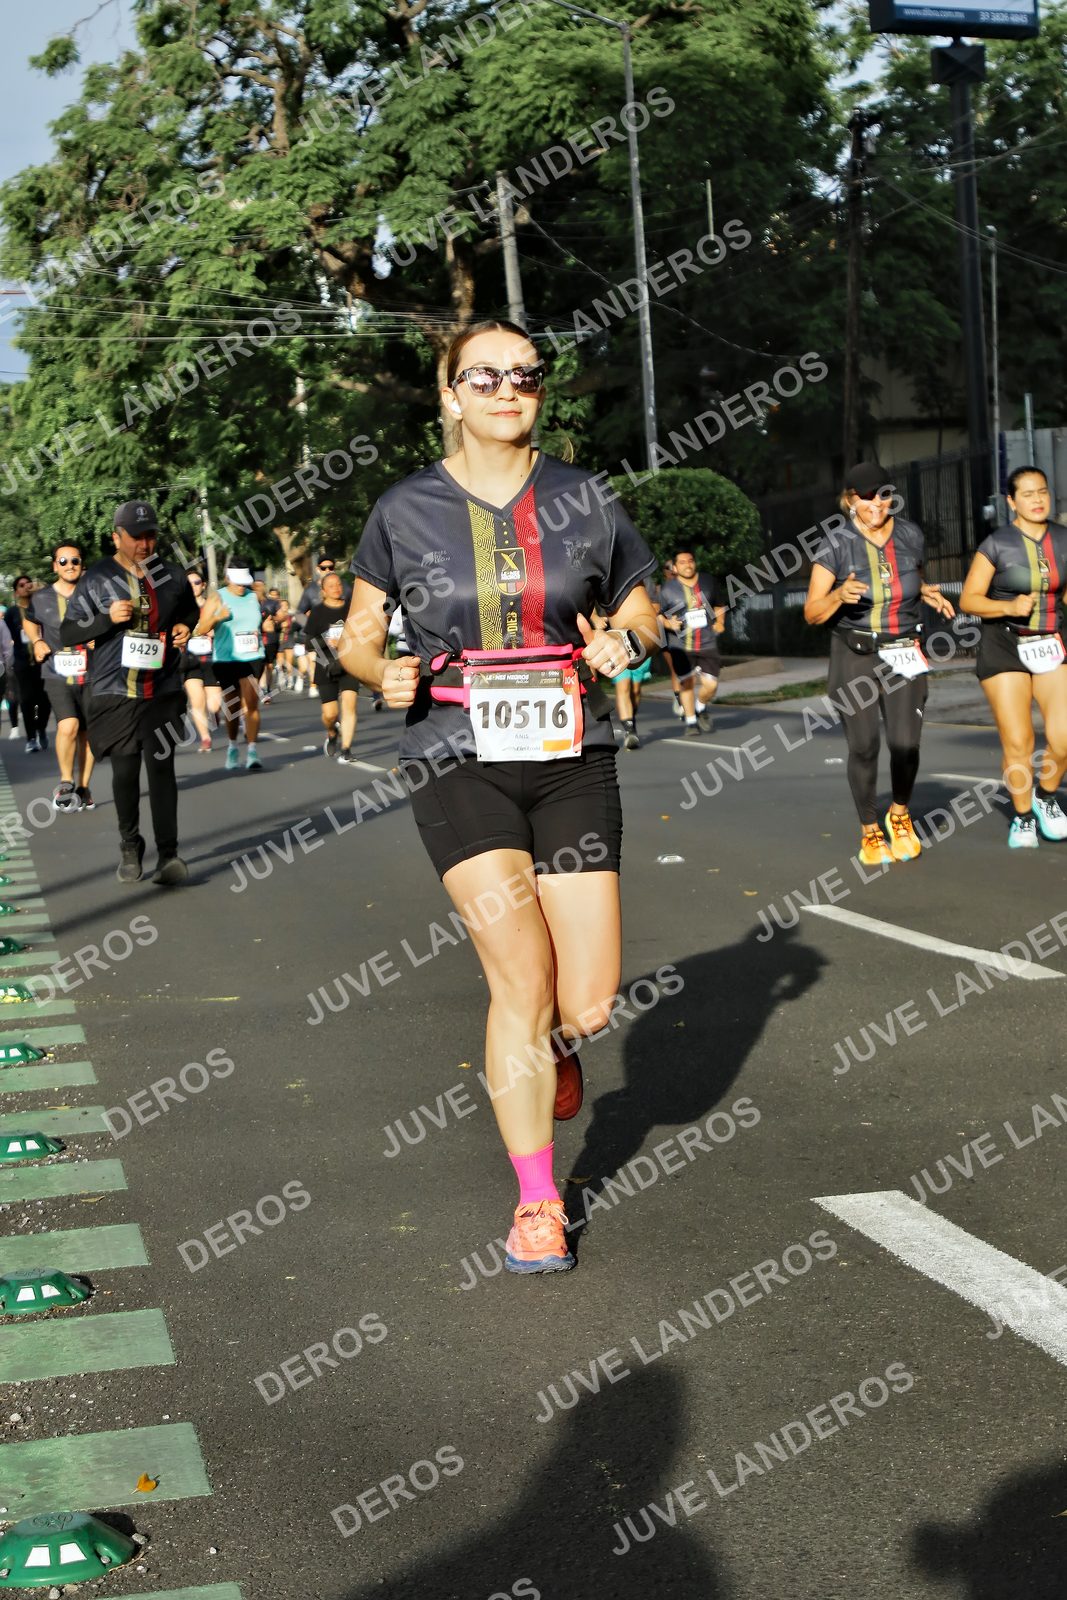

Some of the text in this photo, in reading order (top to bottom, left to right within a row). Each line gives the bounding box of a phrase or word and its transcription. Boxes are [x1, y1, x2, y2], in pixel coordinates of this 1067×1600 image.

[130, 642, 158, 656] 9429
[1022, 644, 1060, 661] 11841
[477, 699, 568, 729] 10516
